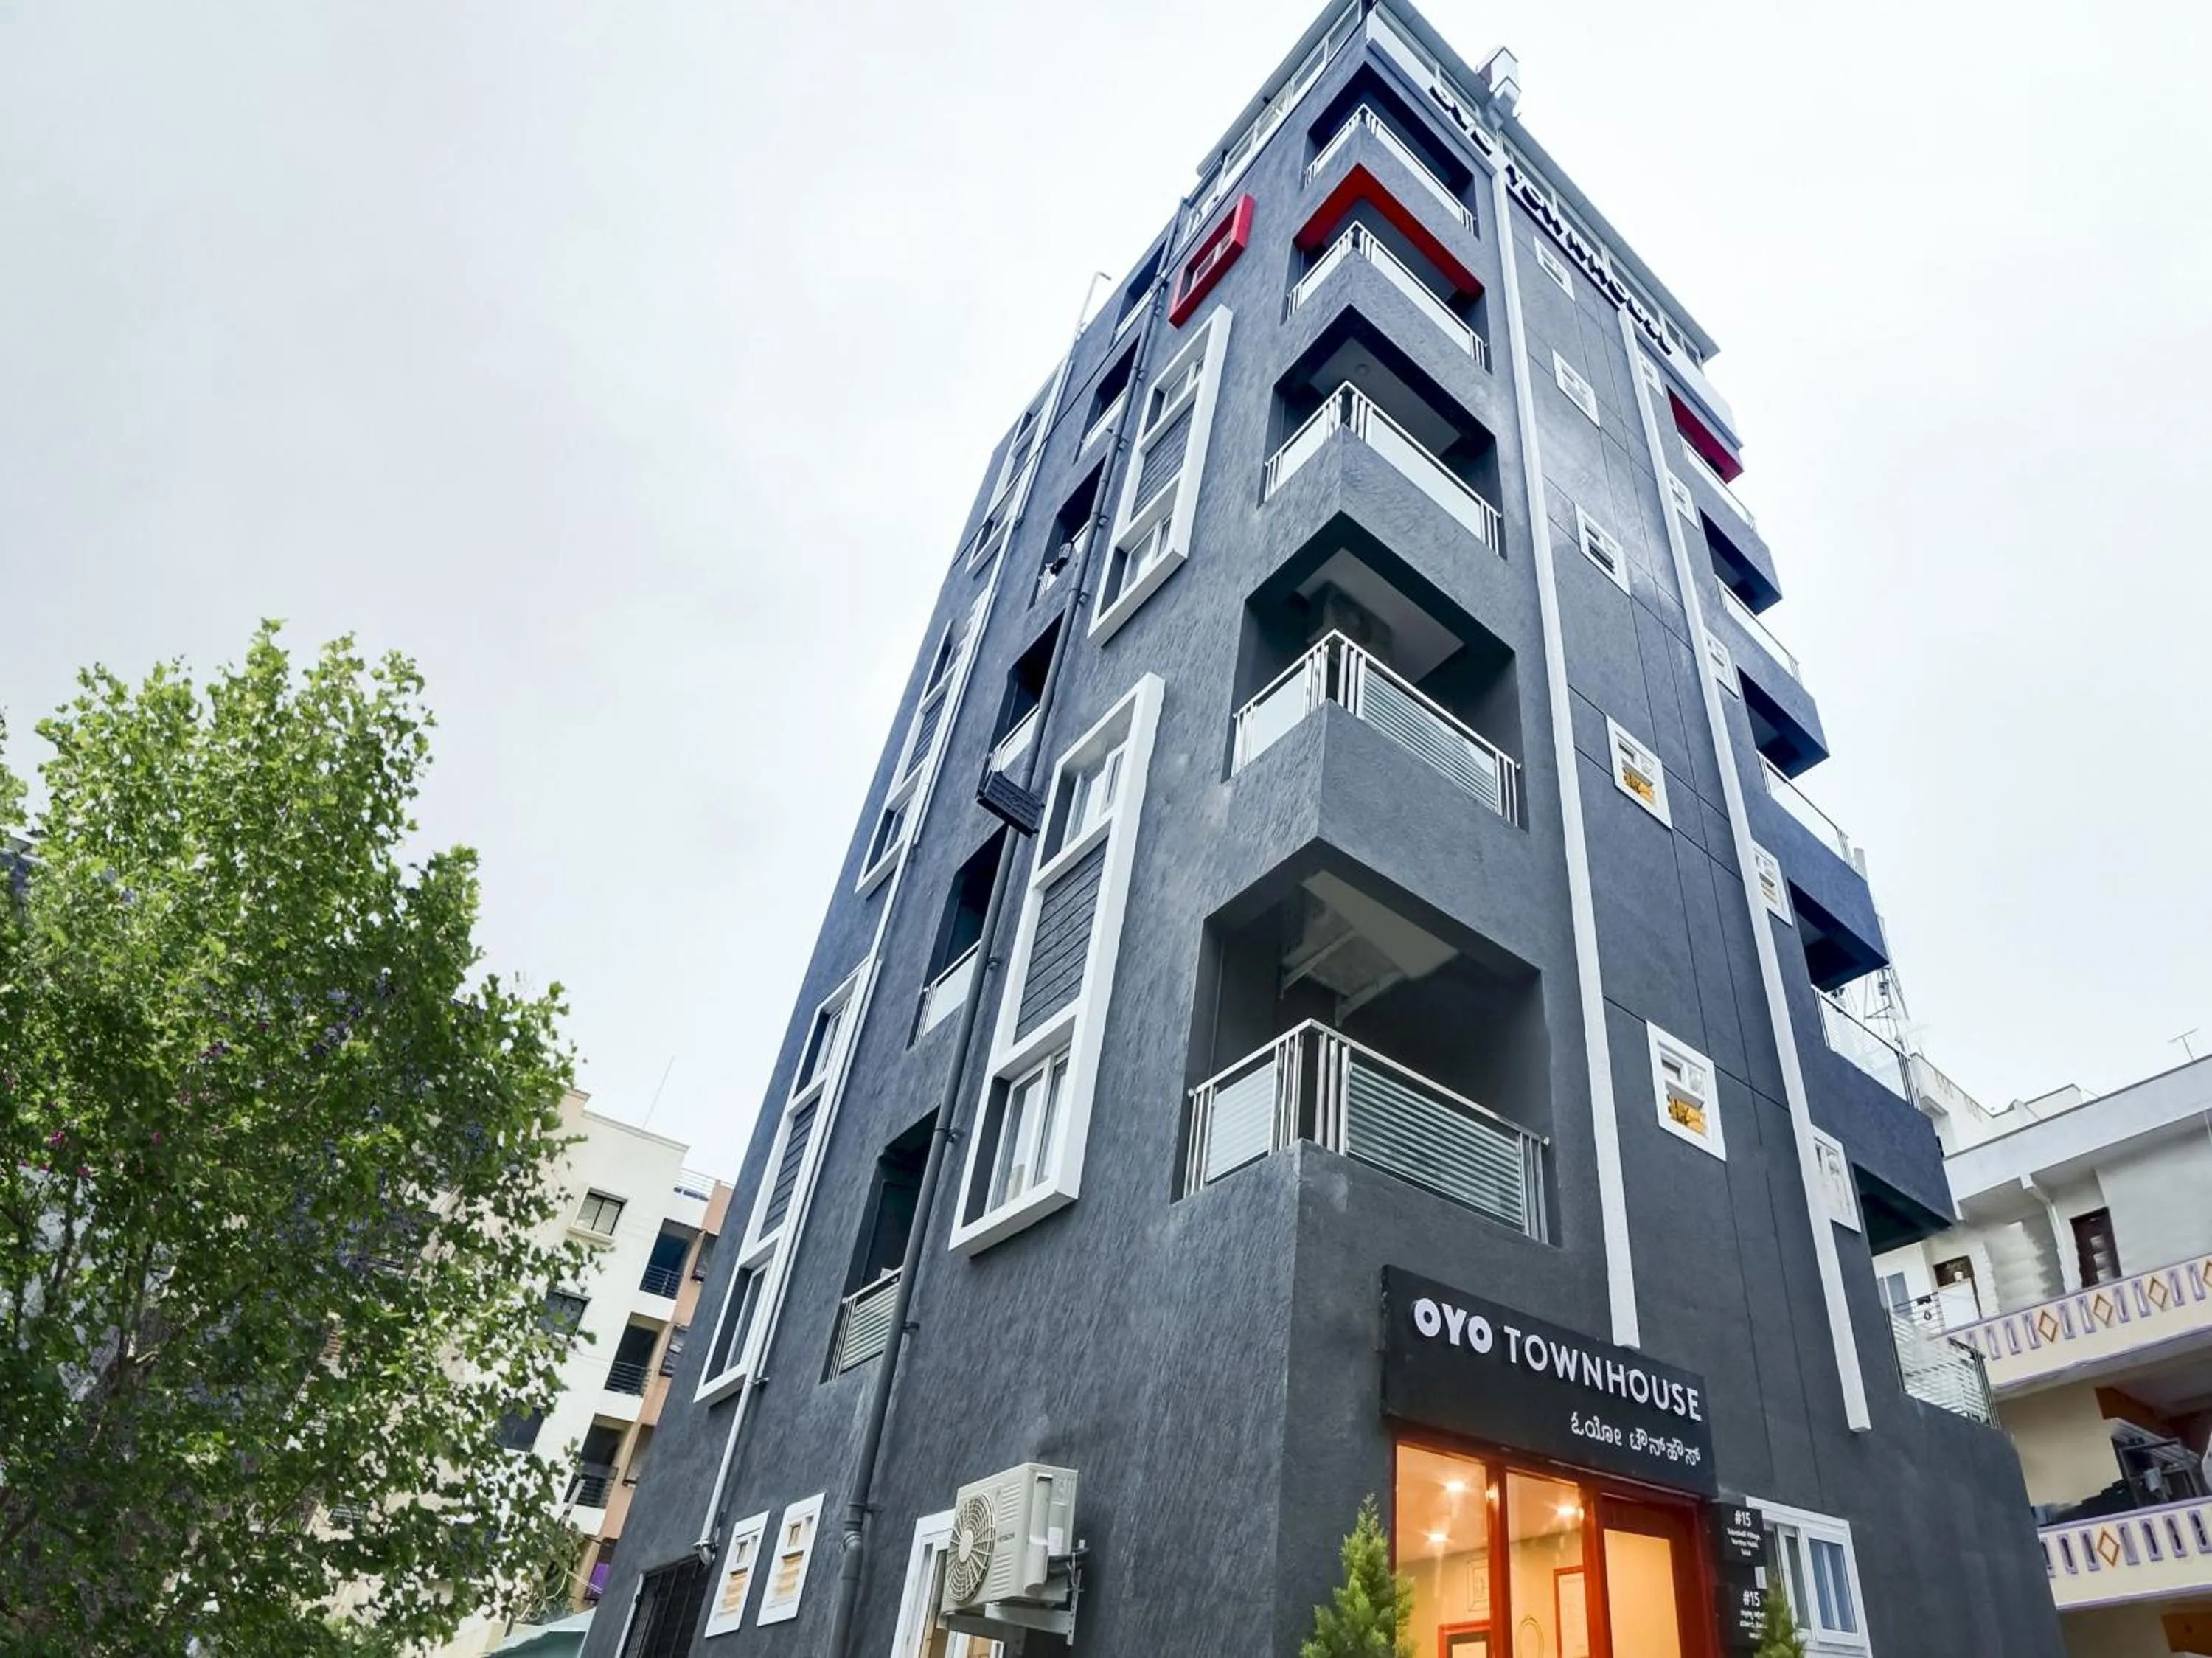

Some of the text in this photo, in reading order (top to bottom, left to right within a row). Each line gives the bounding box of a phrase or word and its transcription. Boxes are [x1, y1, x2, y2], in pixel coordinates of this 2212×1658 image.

[1413, 1297, 1702, 1422] OYO TOWNHOUSE
[1571, 1411, 1623, 1446] ಓಯೋ
[1734, 1510, 1752, 1527] #15
[1742, 1589, 1761, 1607] #15
